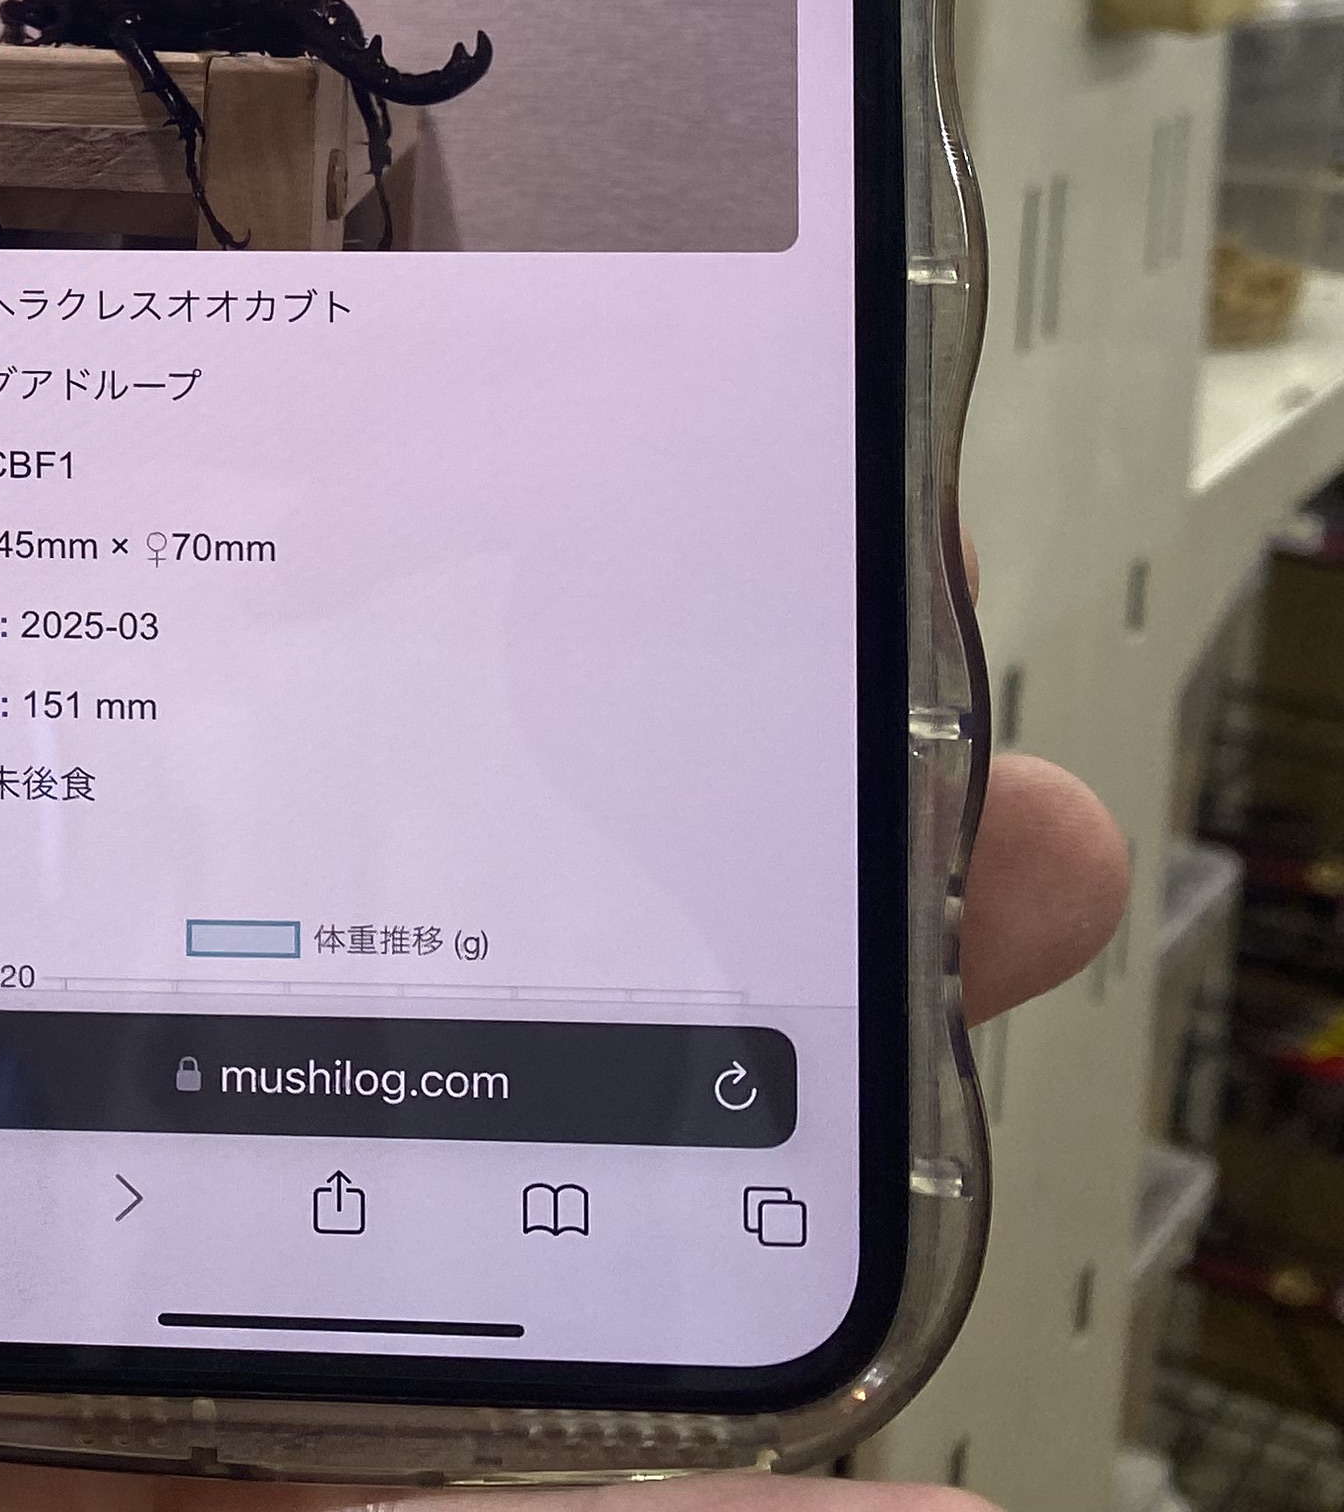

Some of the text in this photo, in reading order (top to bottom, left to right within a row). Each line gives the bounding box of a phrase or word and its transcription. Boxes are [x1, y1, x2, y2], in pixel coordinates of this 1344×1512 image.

[22, 611, 158, 640] 2025-03
[25, 690, 78, 718] 151
[97, 699, 156, 720] mm
[314, 924, 488, 960] 体重推移 (g)
[222, 1060, 508, 1104] mushilog.com
